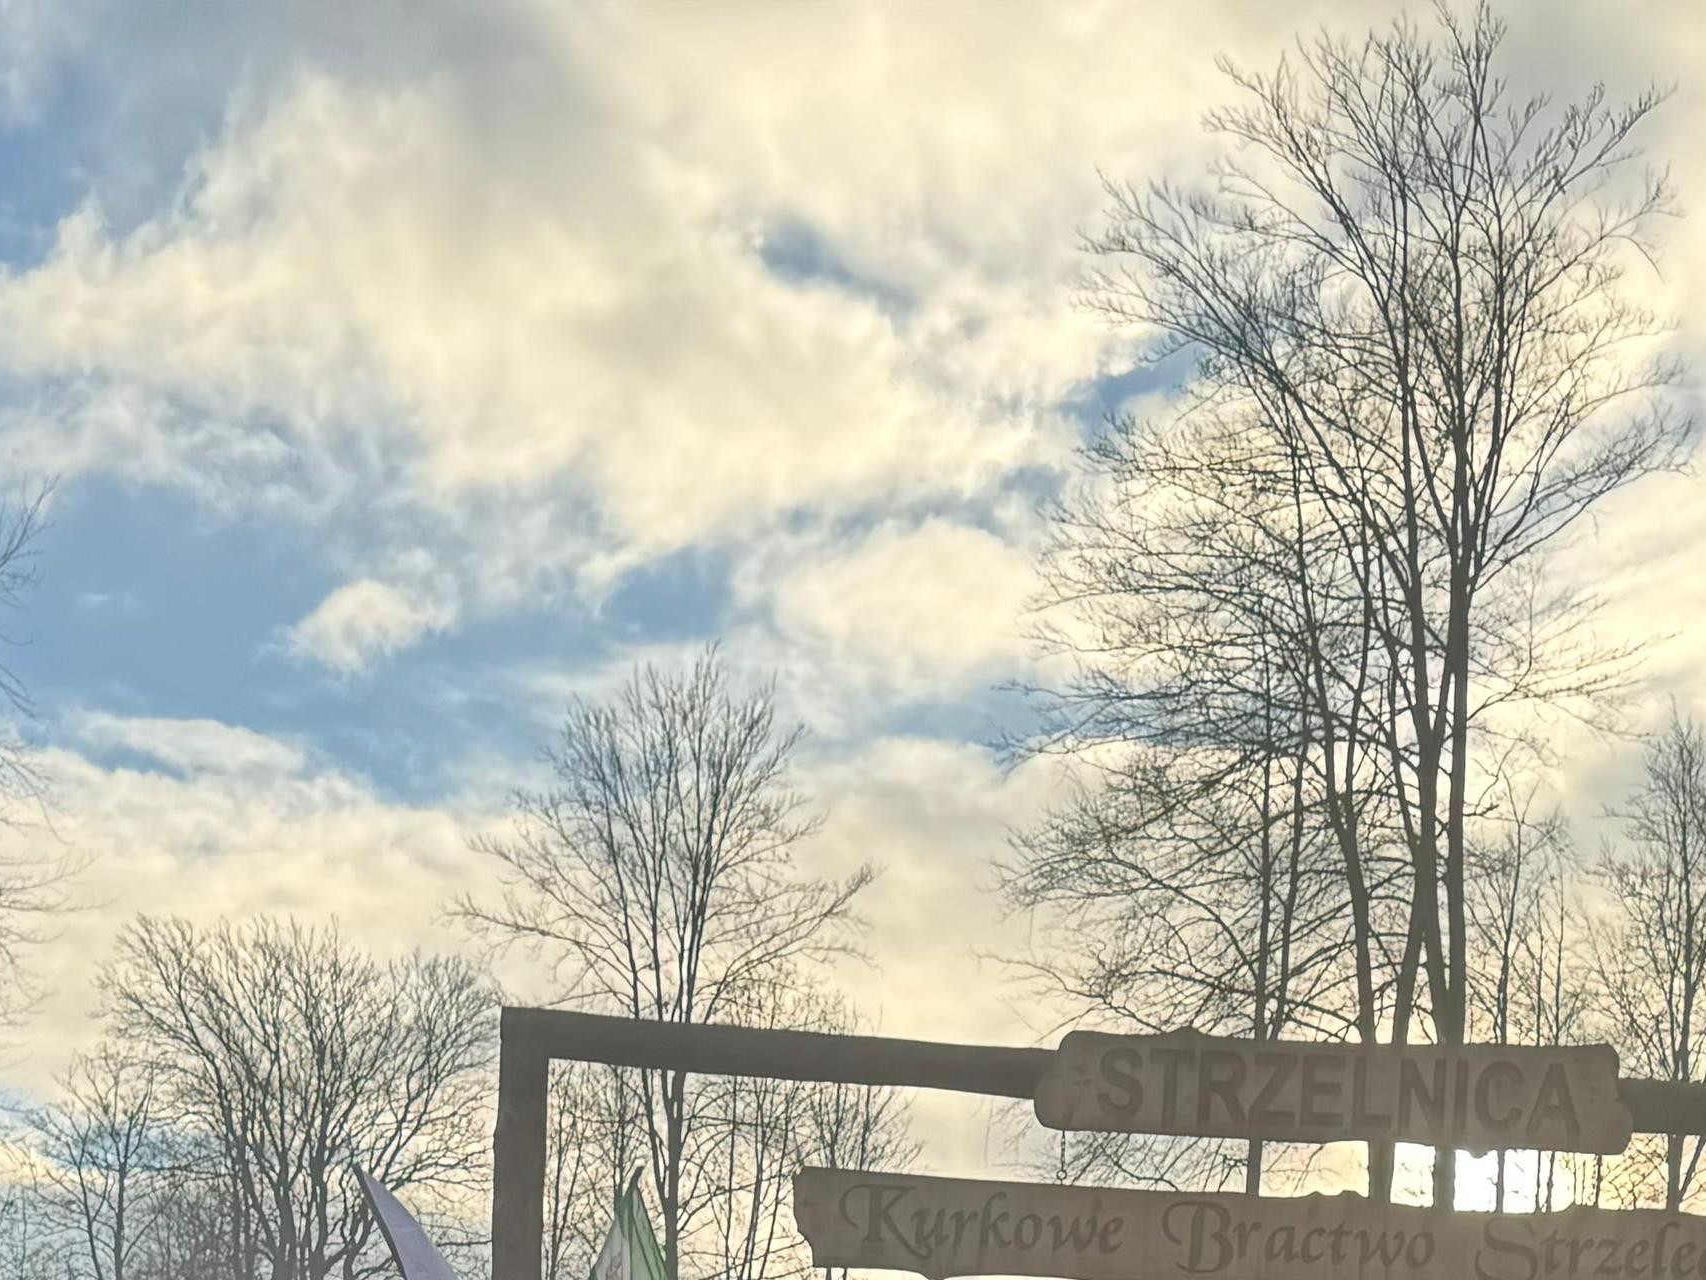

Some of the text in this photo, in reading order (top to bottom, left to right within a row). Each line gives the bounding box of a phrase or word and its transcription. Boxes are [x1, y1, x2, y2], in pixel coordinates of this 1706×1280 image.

[1096, 1045, 1581, 1134] STRZELNICA
[839, 1183, 1124, 1260] Kurkowe
[1162, 1199, 1435, 1275] Bractwo
